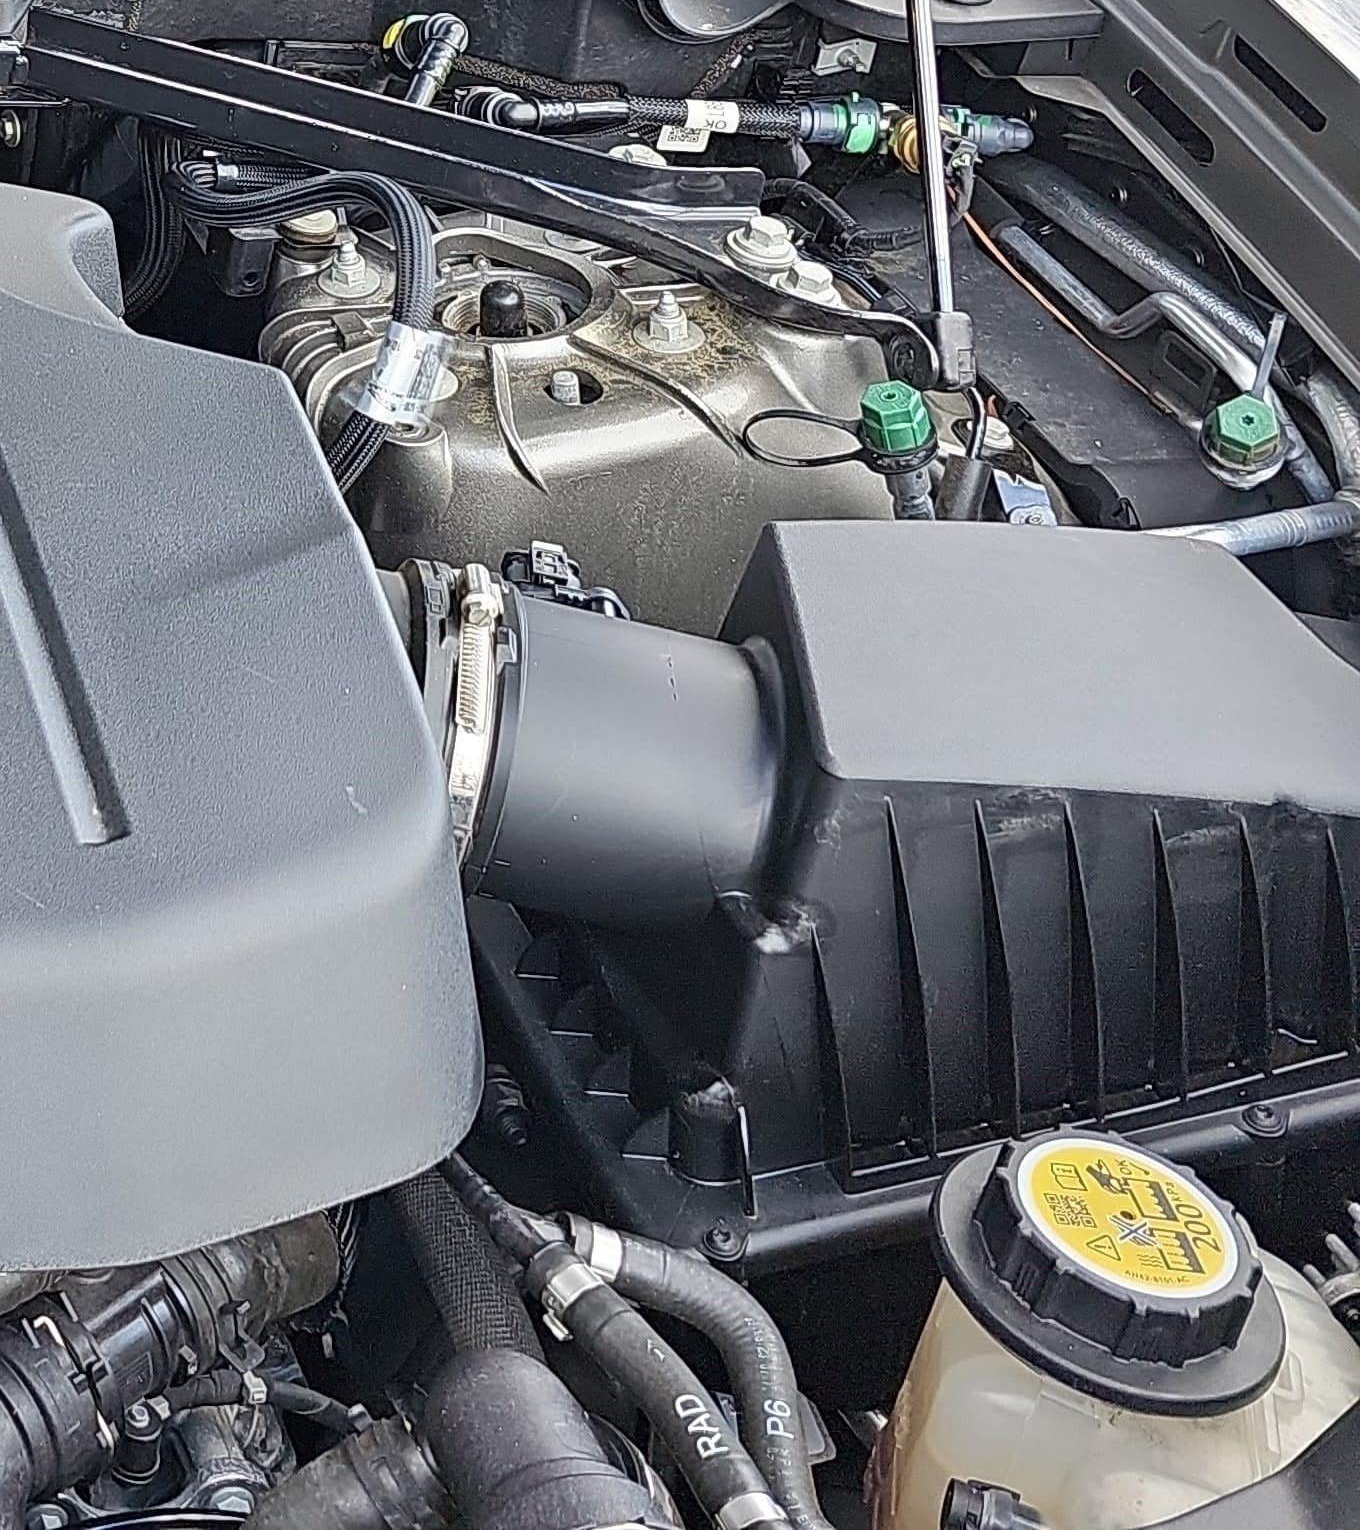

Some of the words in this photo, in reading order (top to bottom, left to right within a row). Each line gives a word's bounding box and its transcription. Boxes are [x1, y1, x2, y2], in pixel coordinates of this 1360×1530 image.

[1113, 1158, 1133, 1177] OK
[1177, 1203, 1222, 1253] 200
[674, 1393, 730, 1460] RAD
[763, 1398, 795, 1440] P6
